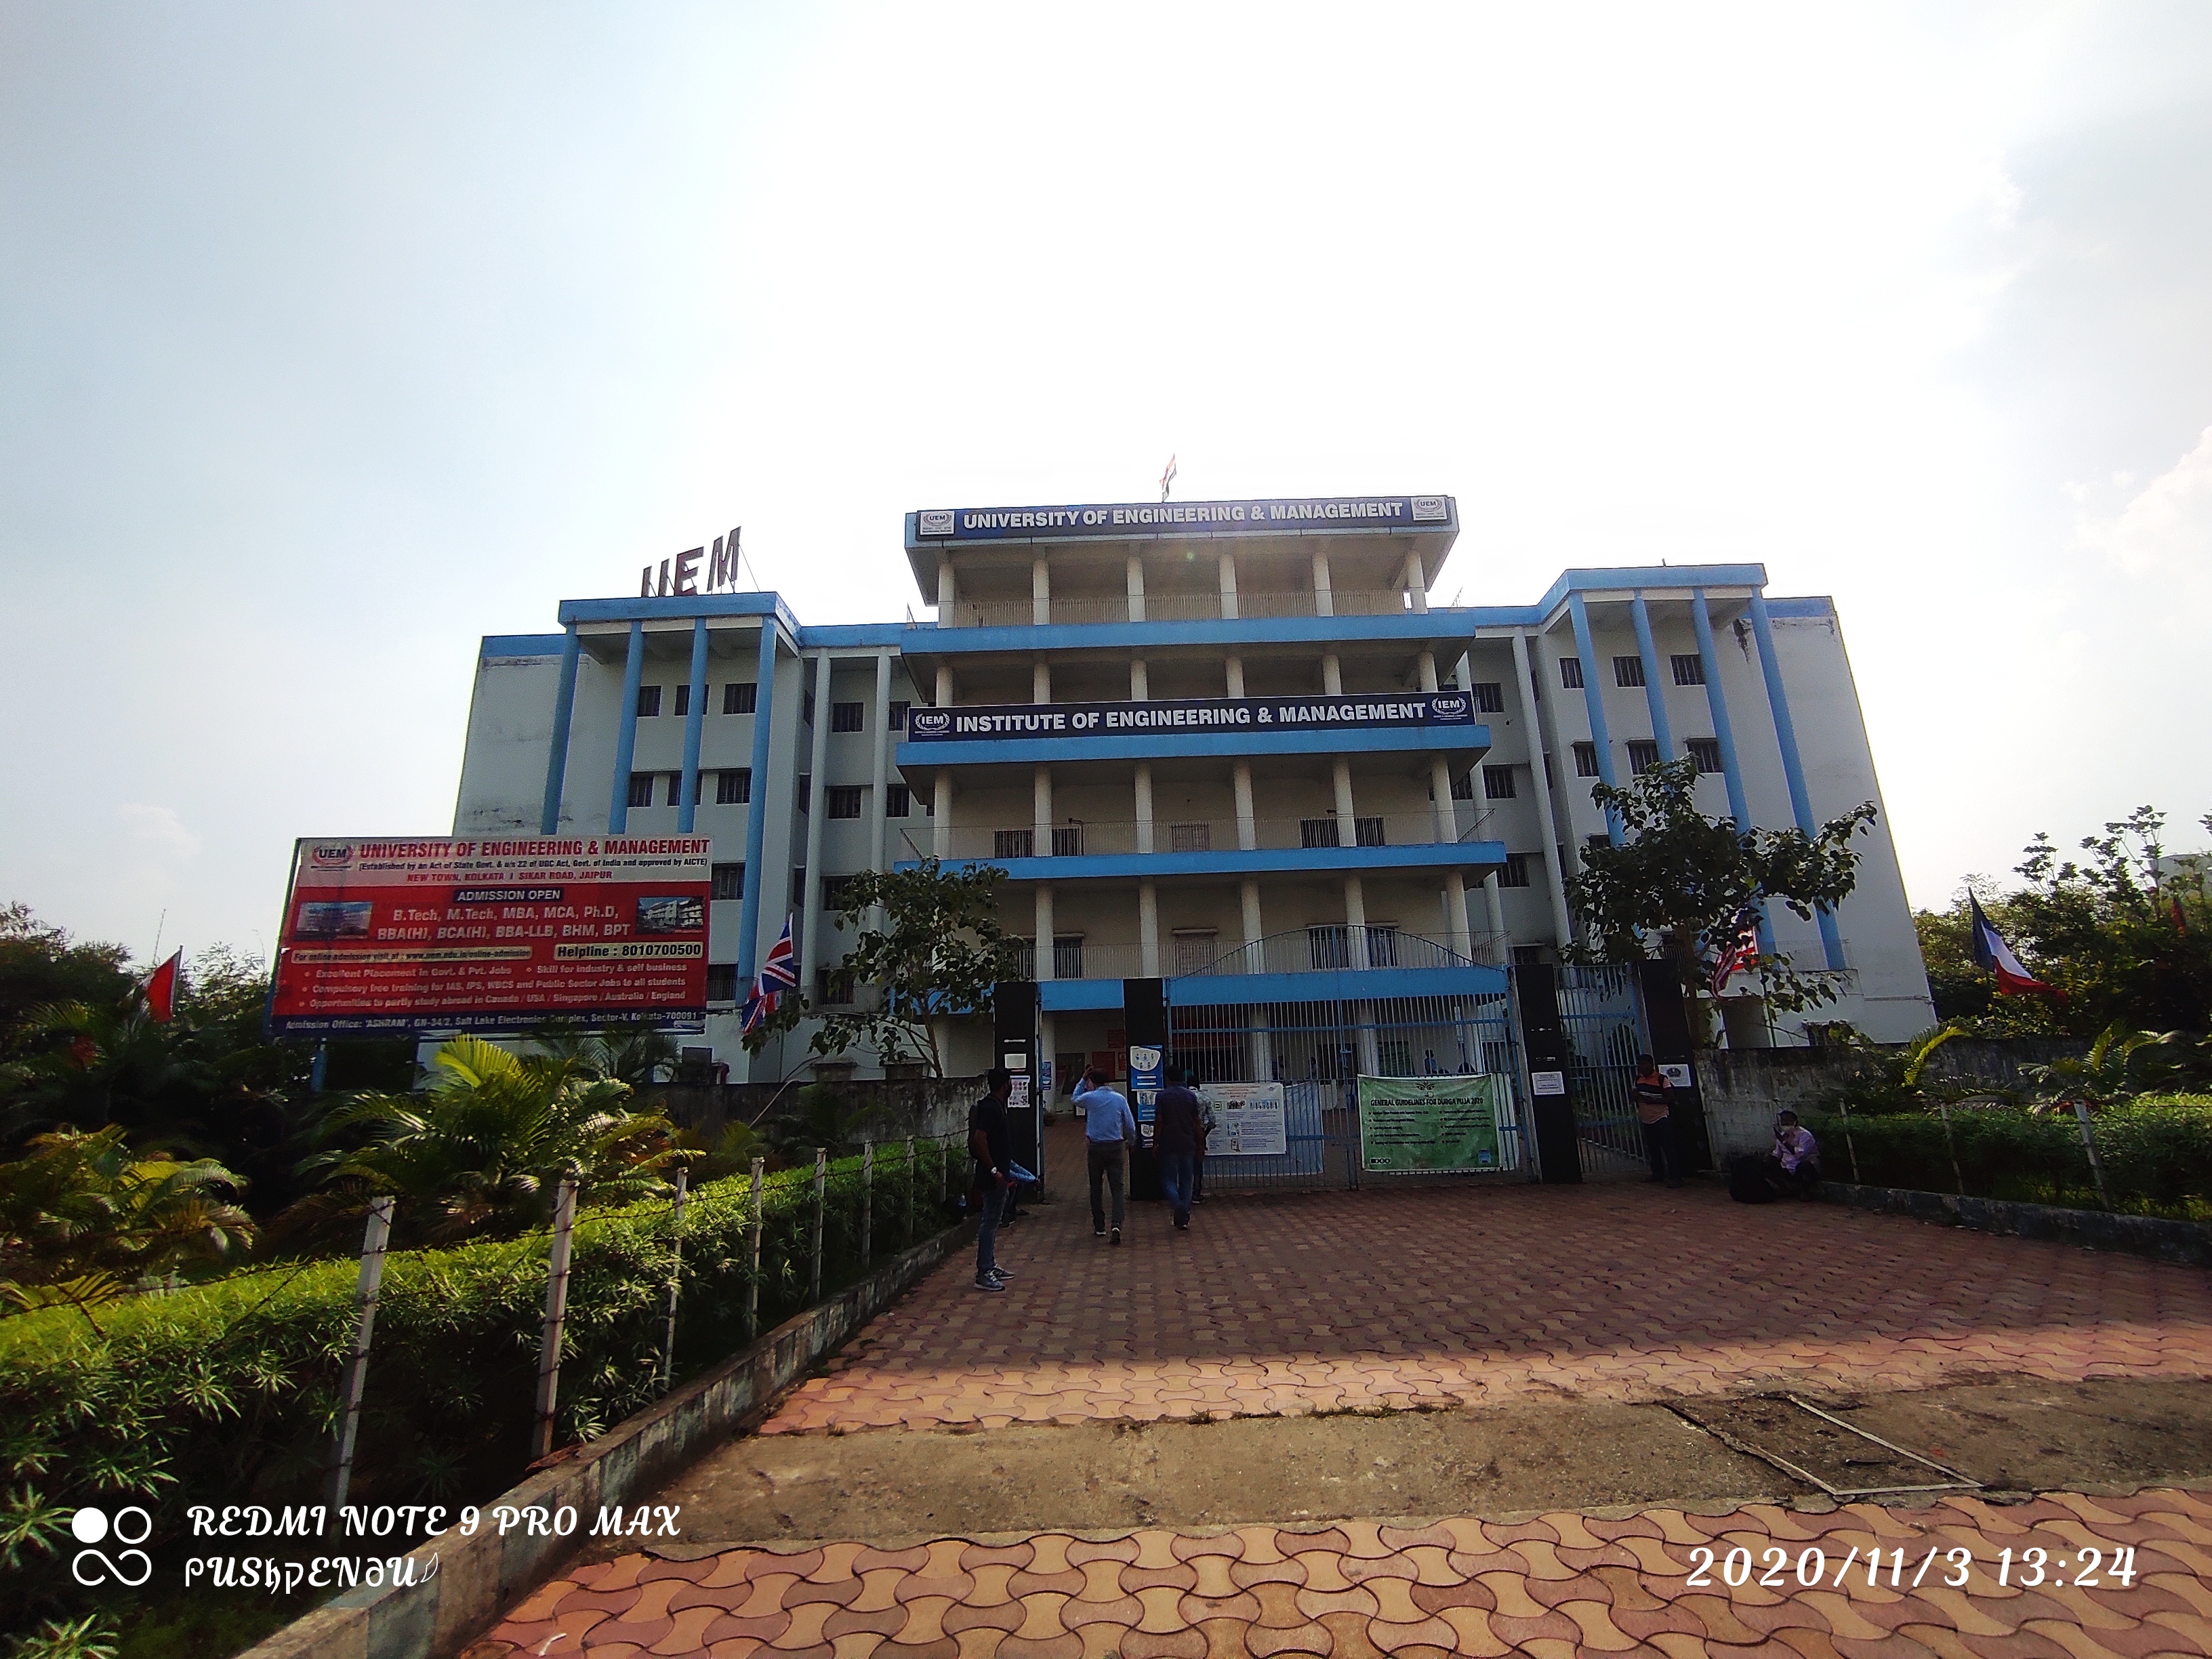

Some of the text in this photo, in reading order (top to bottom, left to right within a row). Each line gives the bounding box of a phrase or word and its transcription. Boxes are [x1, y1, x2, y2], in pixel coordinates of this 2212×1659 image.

[964, 501, 1403, 529] UNIVERSITY OF ENGINEERING & MANAGEMENT
[1438, 700, 1460, 708] IEM
[922, 716, 943, 724] IEM
[956, 703, 1426, 733] INSTITUTE OF ENGINEERING & MANAGEMENT
[319, 849, 346, 858] UEM
[360, 839, 710, 858] UNIVERSITY OF ENGINEERING & MANAGEMENT
[407, 862, 415, 870] by
[453, 861, 474, 869] State
[476, 861, 493, 869] Govt.
[593, 859, 601, 867] of
[638, 859, 672, 867] approved
[674, 859, 682, 867] by
[684, 858, 708, 867] AICTE)
[549, 872, 577, 880] ROAD,
[457, 890, 560, 901] ADMISSION OPEN
[393, 905, 618, 922] B.Tech, M.Tech, MBA, MCA, Ph.D,
[377, 924, 631, 941] BBA(H), BCA(H), BBA-LLB, BHM, BPT
[557, 944, 701, 958] Helpline : 8010700500
[316, 966, 512, 978] Excellent Placement in Govt. & Pvt. Jobs
[537, 965, 558, 973] Skill
[560, 964, 575, 972] for
[577, 964, 614, 974] industry
[617, 964, 624, 972] &
[646, 963, 687, 971] business
[312, 985, 367, 994] Compulsory
[392, 984, 429, 993] training
[446, 983, 464, 991] IAS,
[466, 983, 485, 991] IPS,
[488, 981, 514, 989] WBCS
[536, 980, 565, 988] Public
[568, 979, 596, 987] Sector
[599, 979, 621, 987] Jobs
[634, 978, 646, 986] all
[310, 1000, 371, 1008] Opportunities
[385, 998, 412, 1008] partly
[415, 998, 440, 1006] study
[442, 996, 472, 1004] abroad
[485, 995, 519, 1004] Canada
[553, 994, 598, 1003] Singapore
[605, 992, 644, 1000] Australia
[651, 991, 686, 1000] England
[286, 1021, 329, 1029] Admission
[332, 1020, 362, 1028] Office:
